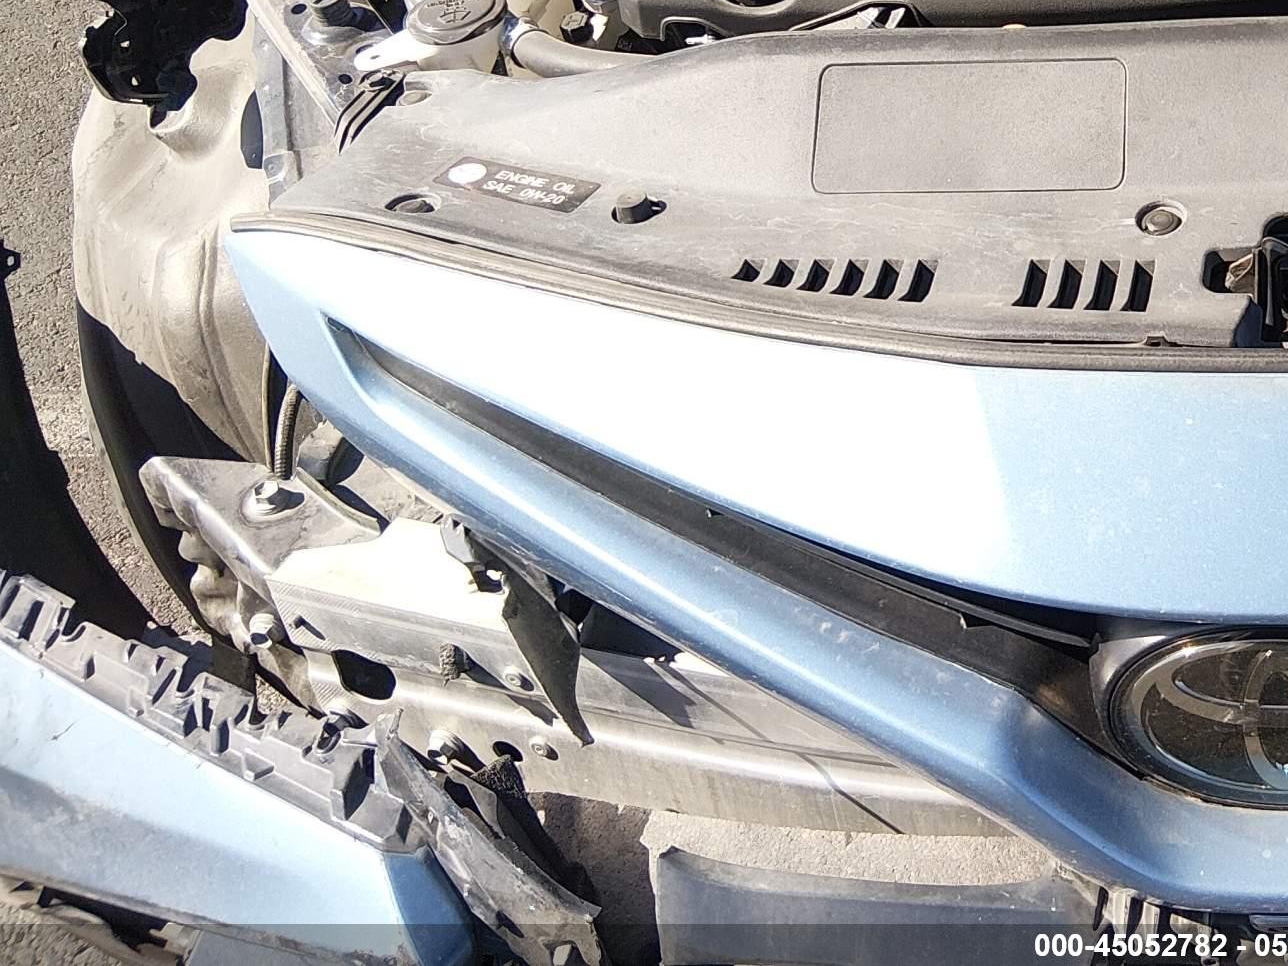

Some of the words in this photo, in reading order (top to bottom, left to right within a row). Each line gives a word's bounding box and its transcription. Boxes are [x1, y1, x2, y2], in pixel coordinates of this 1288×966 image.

[482, 180, 516, 194] SAE
[519, 187, 566, 205] 0W-20
[494, 170, 550, 188] ENGINE
[552, 181, 576, 195] OIL
